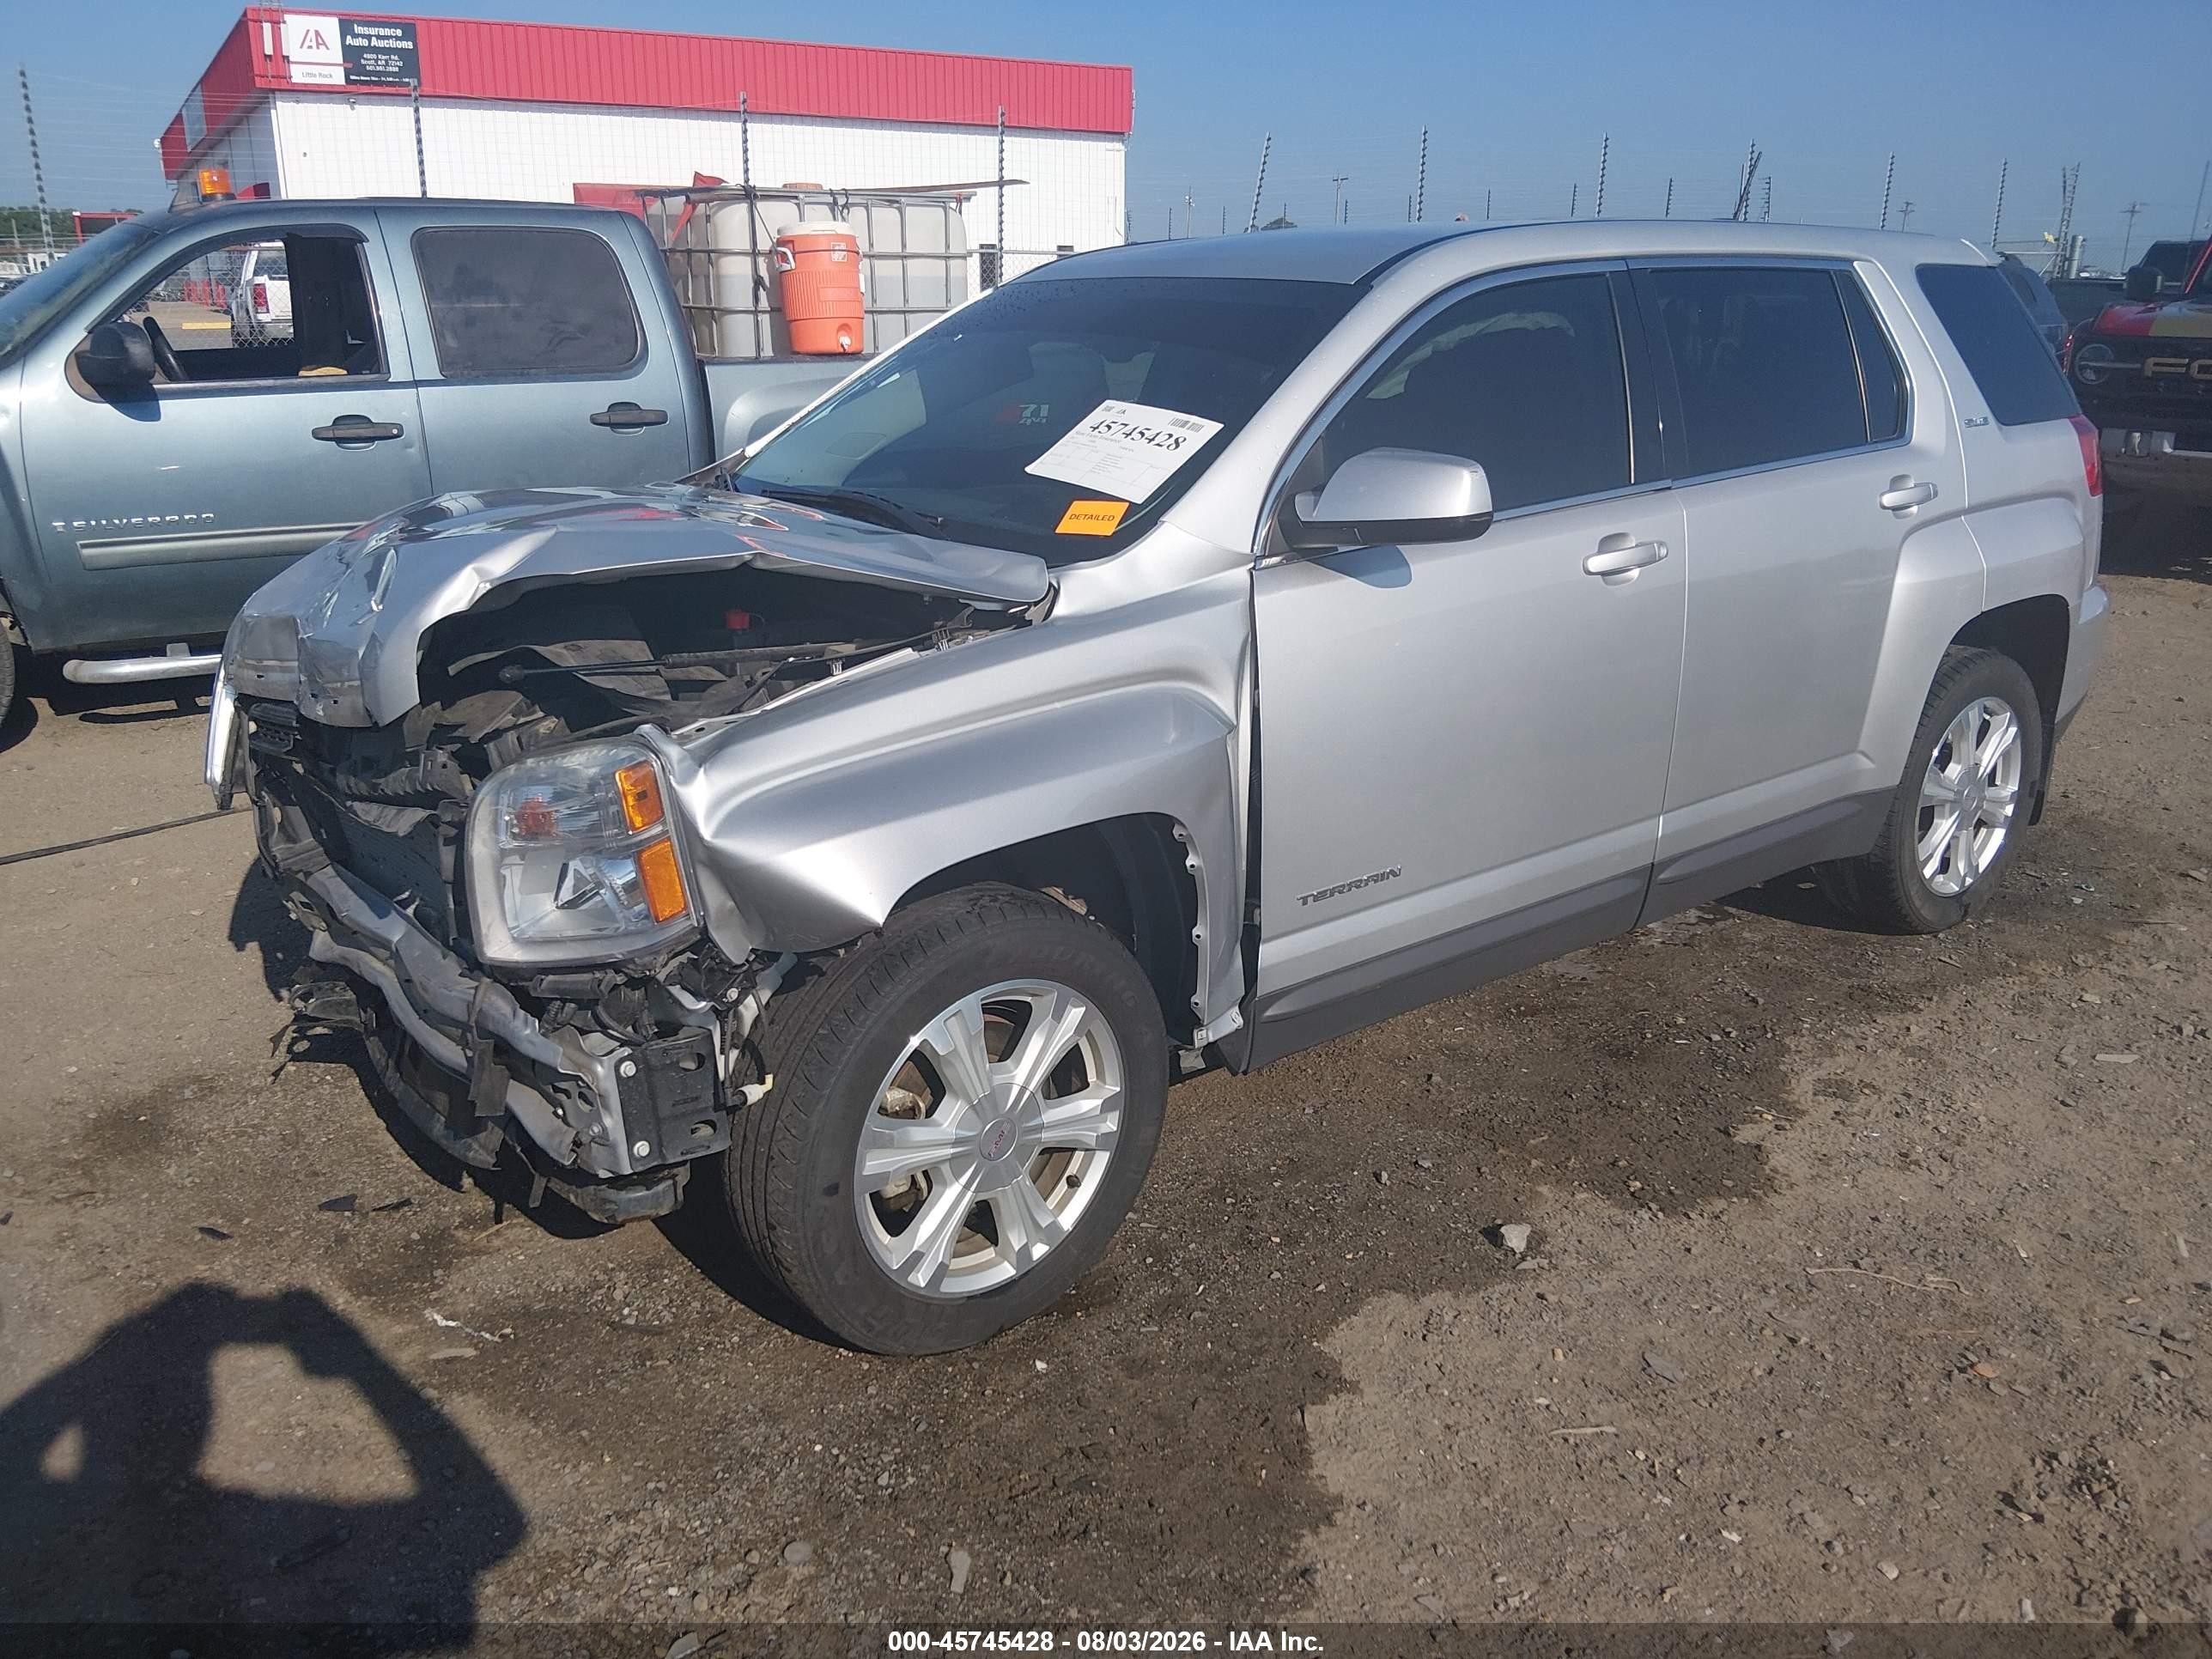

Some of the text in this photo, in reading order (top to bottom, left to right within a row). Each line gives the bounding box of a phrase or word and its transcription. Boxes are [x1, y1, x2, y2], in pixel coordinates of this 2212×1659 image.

[354, 23, 403, 37] Insurance
[345, 35, 414, 49] Auto Auctions
[1088, 419, 1188, 453] 45745428
[72, 514, 215, 532] SILVERADO
[1068, 513, 1115, 522] DETAILED
[1296, 864, 1402, 907] TERRAIN
